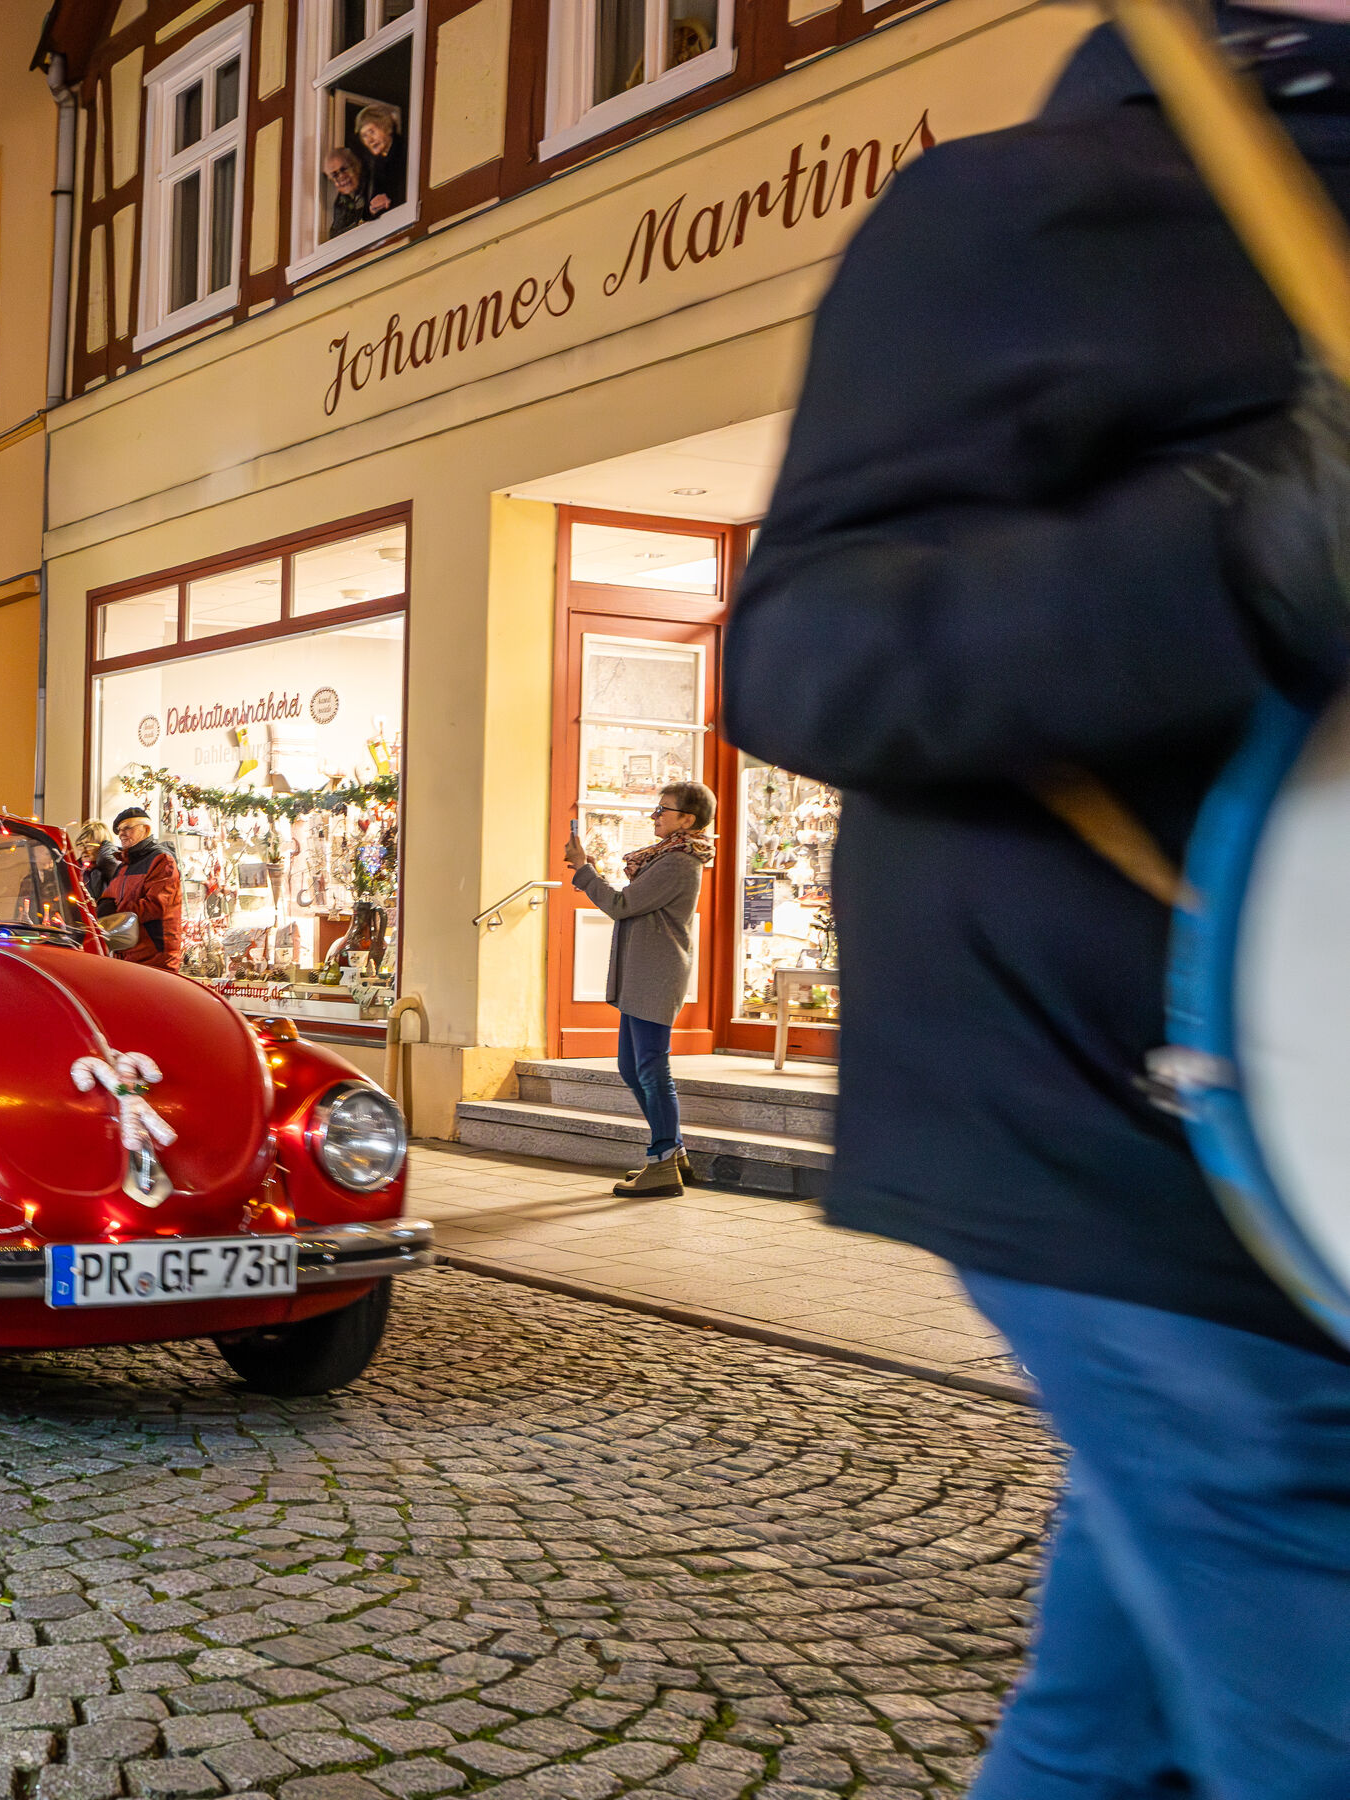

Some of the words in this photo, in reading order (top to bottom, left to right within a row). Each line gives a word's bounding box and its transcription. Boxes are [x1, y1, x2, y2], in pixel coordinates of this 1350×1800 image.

[323, 254, 576, 417] Johannes
[80, 1251, 133, 1297] PR
[160, 1247, 213, 1293] GF
[221, 1243, 292, 1289] 73H
